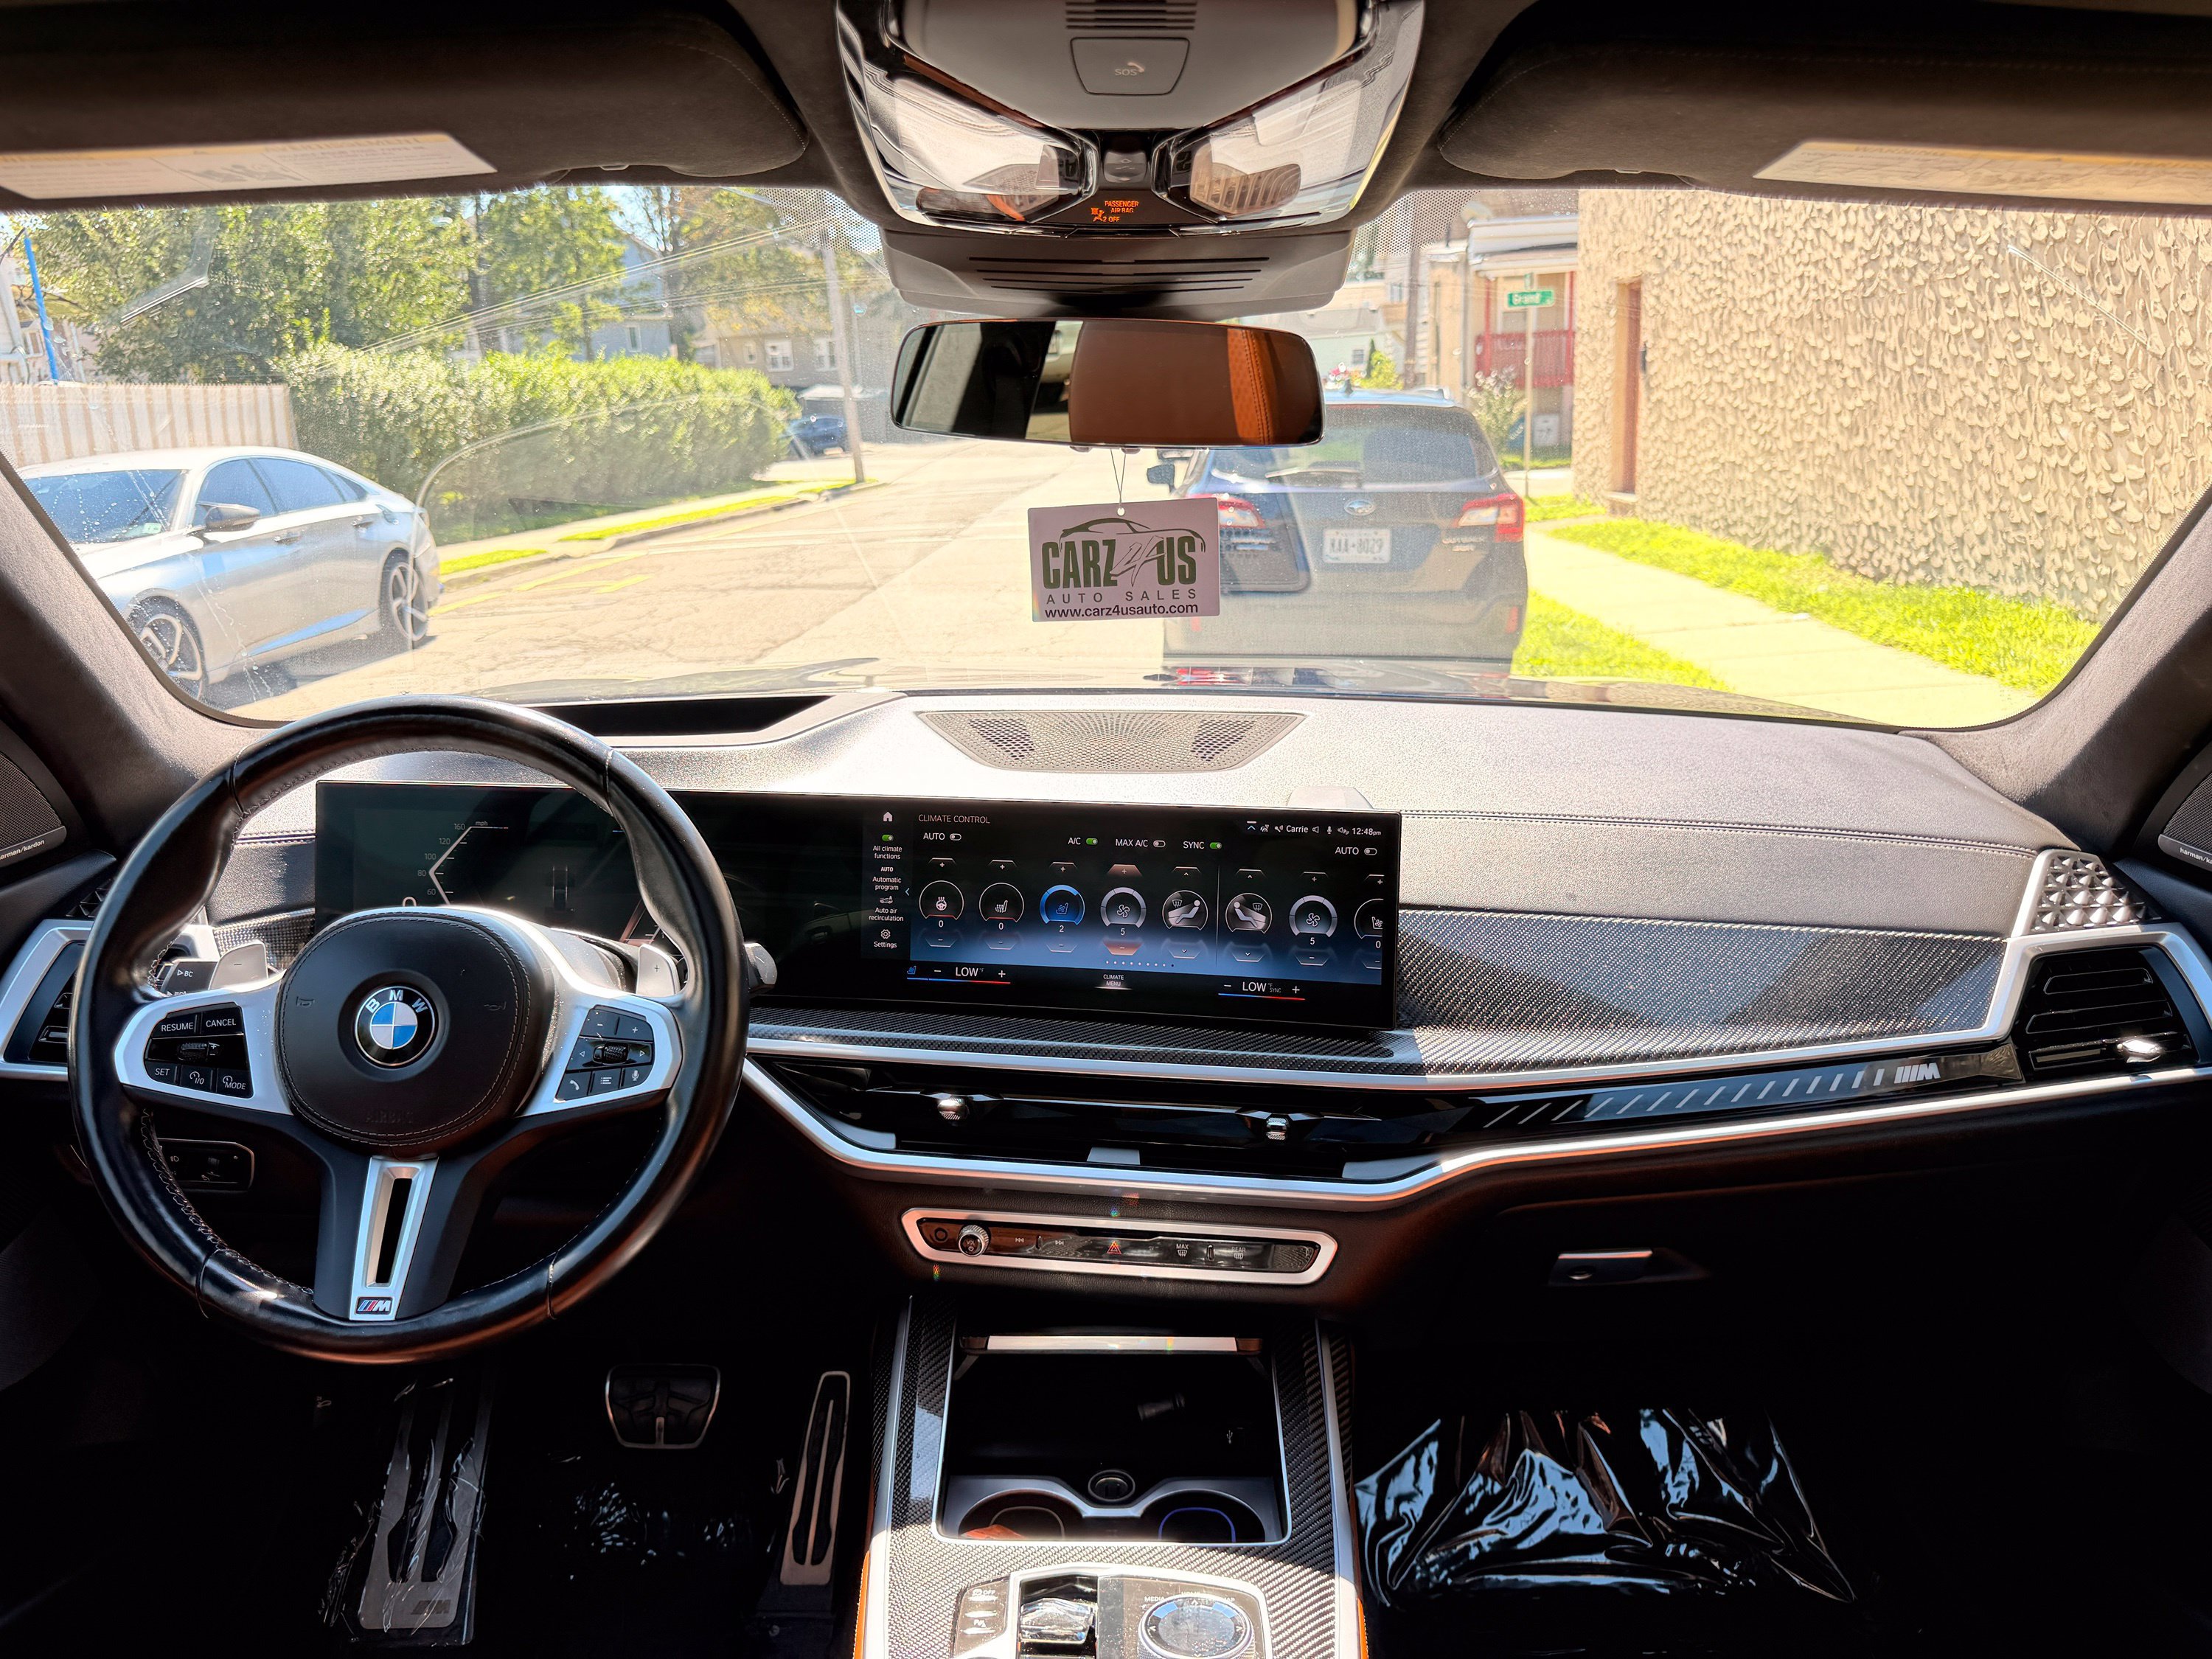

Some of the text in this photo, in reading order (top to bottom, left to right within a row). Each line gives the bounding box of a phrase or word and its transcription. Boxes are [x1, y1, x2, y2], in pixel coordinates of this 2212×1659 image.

[1046, 588, 1196, 604] AUTO SALES
[1045, 602, 1199, 617] www.carz4usauto.com
[918, 814, 990, 824] CLIMATE CONTROL
[1352, 827, 1381, 835] 12:48pm
[923, 832, 945, 841] AUTO
[1068, 837, 1081, 845] A/C
[1115, 838, 1148, 848] MAX A/C
[1183, 841, 1205, 849] SYNC
[0, 840, 45, 860] arman/kardon
[1335, 846, 1359, 855] AUTO
[998, 922, 1004, 931] 0
[1310, 937, 1315, 945] 5
[1375, 940, 1381, 948] 0
[956, 967, 978, 977] LOW
[1242, 981, 1267, 992] LOW
[366, 990, 428, 1014] BMW
[161, 1022, 194, 1032] RESUME
[206, 1018, 236, 1028] CANCEL
[155, 1068, 170, 1076] SET
[225, 1082, 246, 1090] MODE
